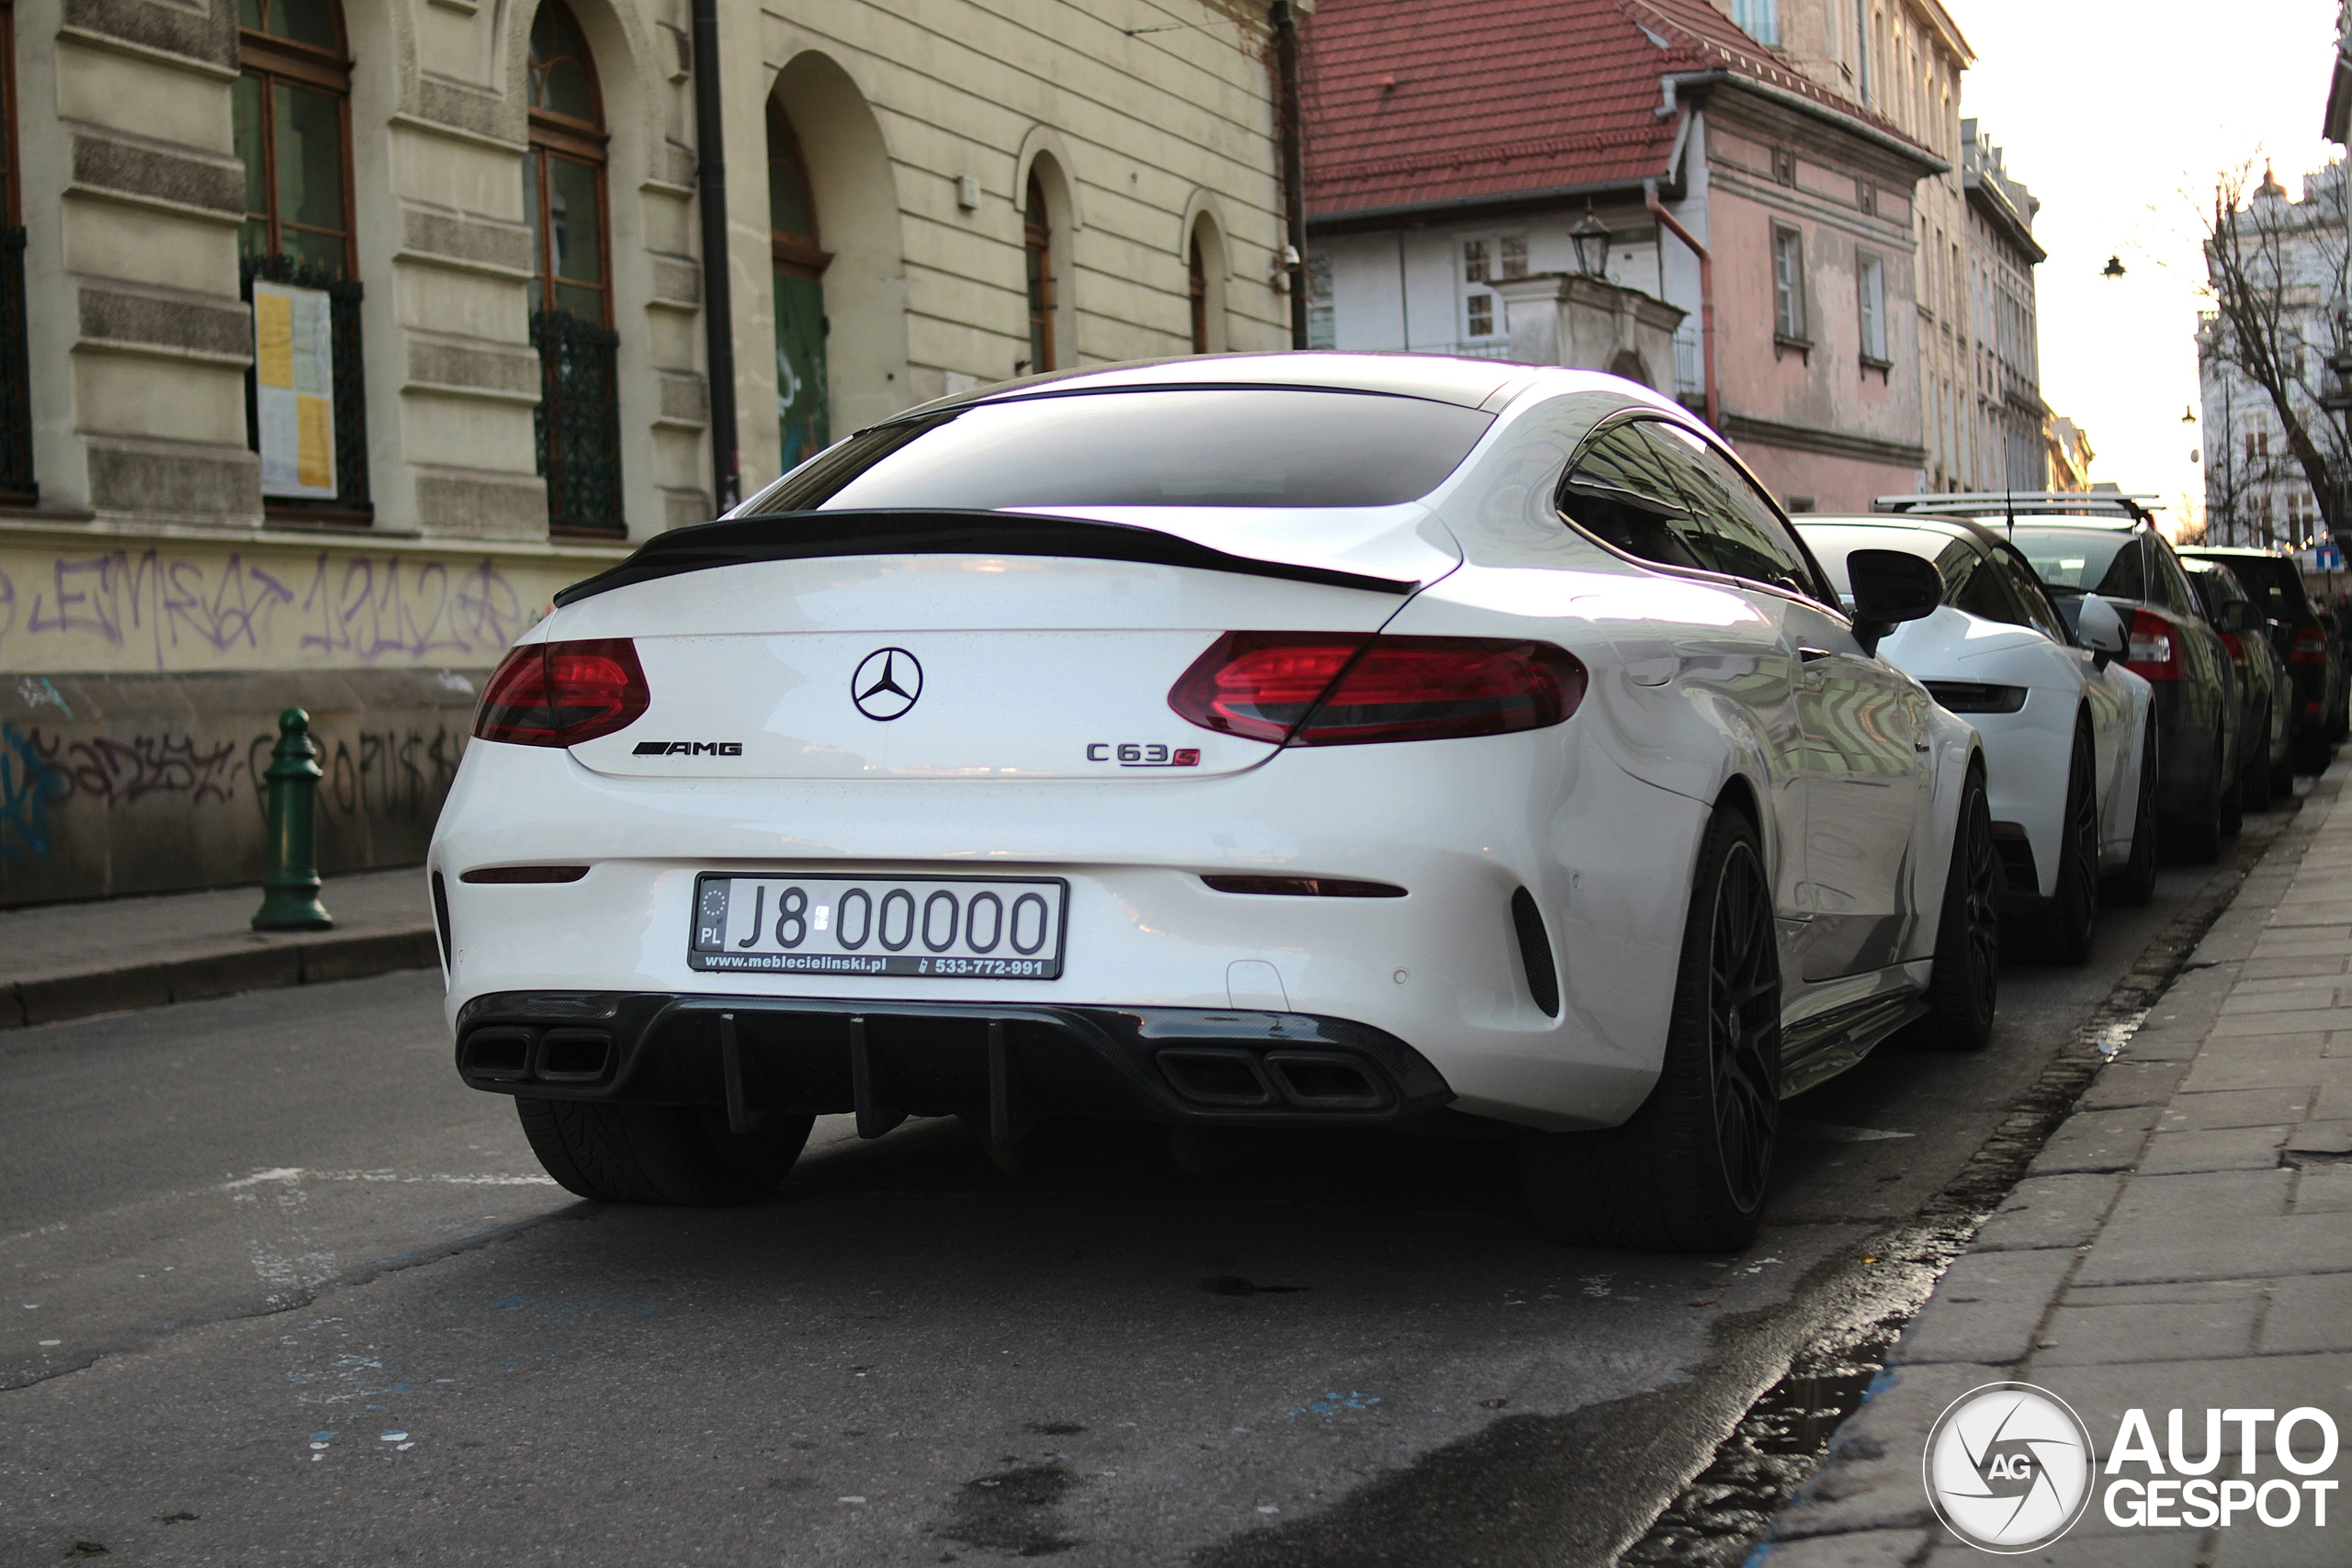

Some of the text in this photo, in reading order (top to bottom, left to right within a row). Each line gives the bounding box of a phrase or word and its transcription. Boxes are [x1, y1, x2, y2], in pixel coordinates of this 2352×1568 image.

[666, 741, 742, 756] AMG
[739, 886, 808, 949] J8
[700, 928, 721, 944] PL
[705, 953, 1044, 976] www.meblecielinski.pl 533-772-991
